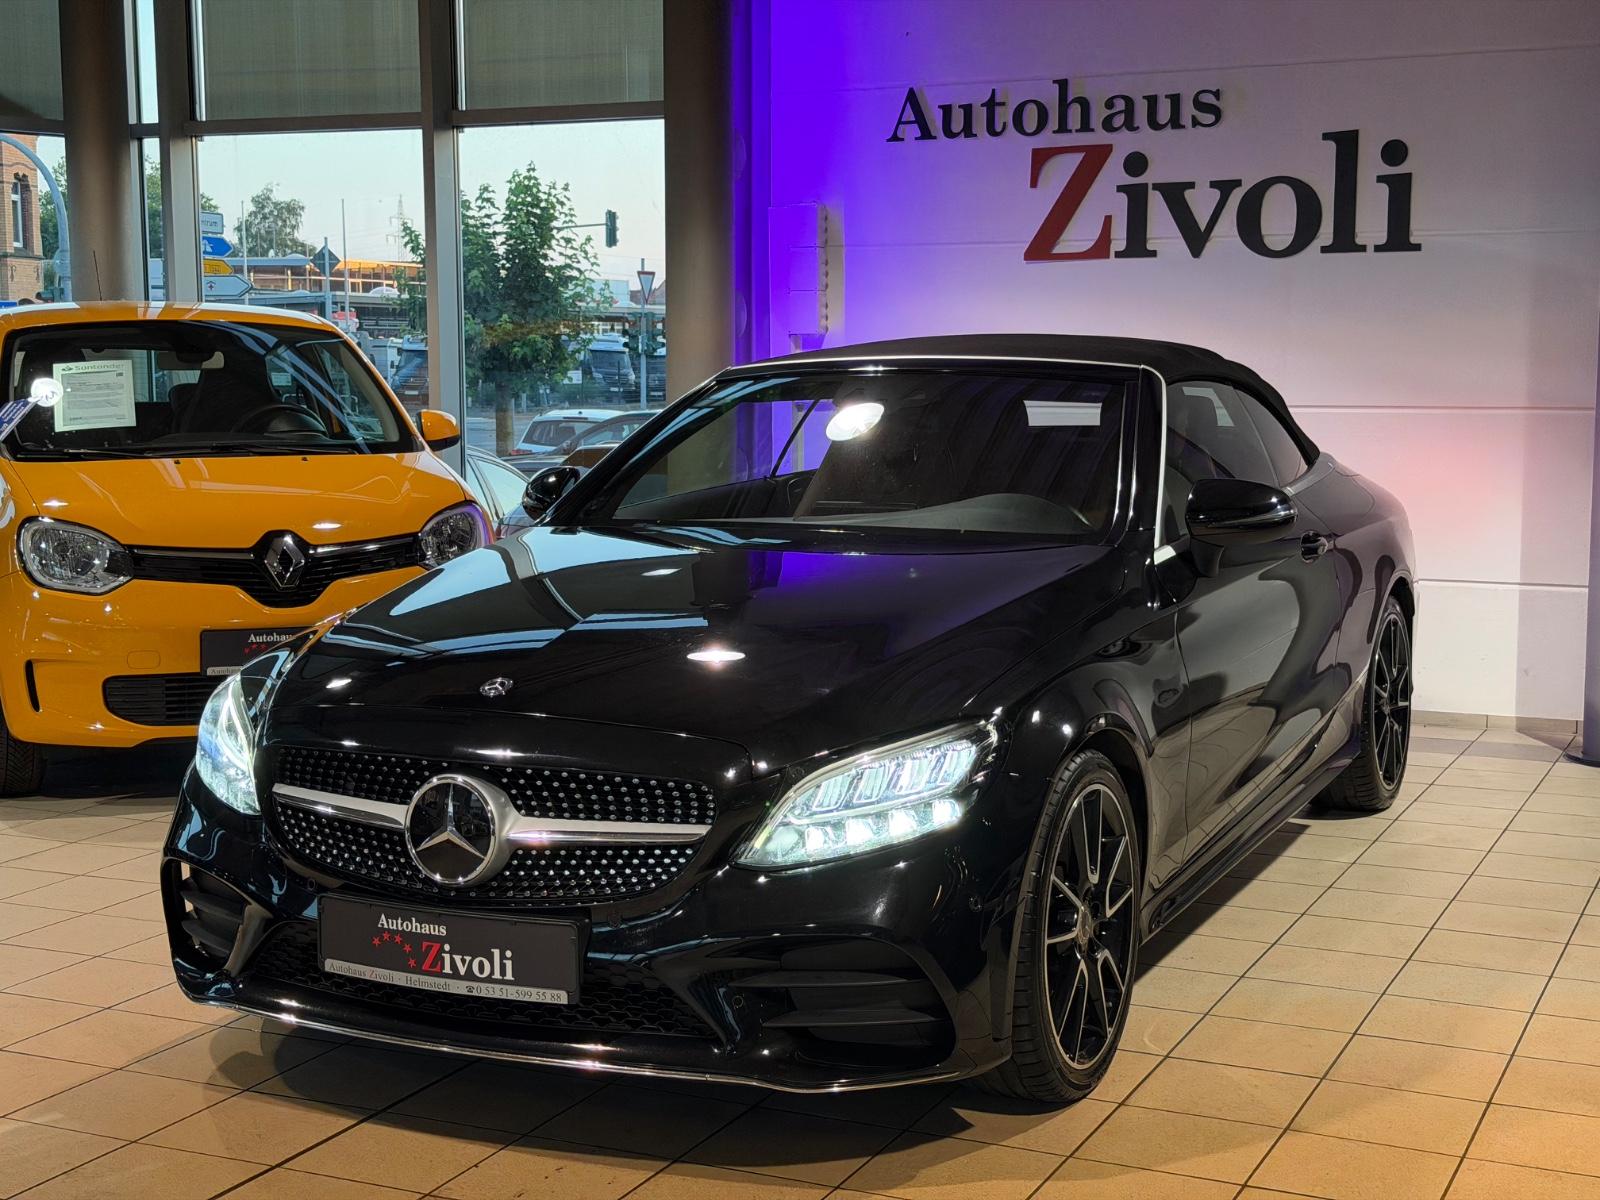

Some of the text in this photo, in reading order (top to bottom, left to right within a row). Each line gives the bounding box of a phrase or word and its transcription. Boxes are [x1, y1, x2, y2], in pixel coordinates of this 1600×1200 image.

[886, 78, 1224, 143] Autohaus
[1024, 129, 1422, 262] Zivoli
[74, 363, 125, 371] Santander
[248, 632, 296, 643] Autohau
[378, 913, 447, 936] Autohaus
[422, 941, 515, 981] Zivoli
[328, 962, 367, 977] Autohaus
[367, 969, 394, 983] Zivoli
[405, 975, 450, 991] Helmstedt
[485, 986, 496, 996] 53
[499, 987, 533, 999] 51-599
[535, 991, 547, 1001] 55
[550, 992, 562, 1003] 88
